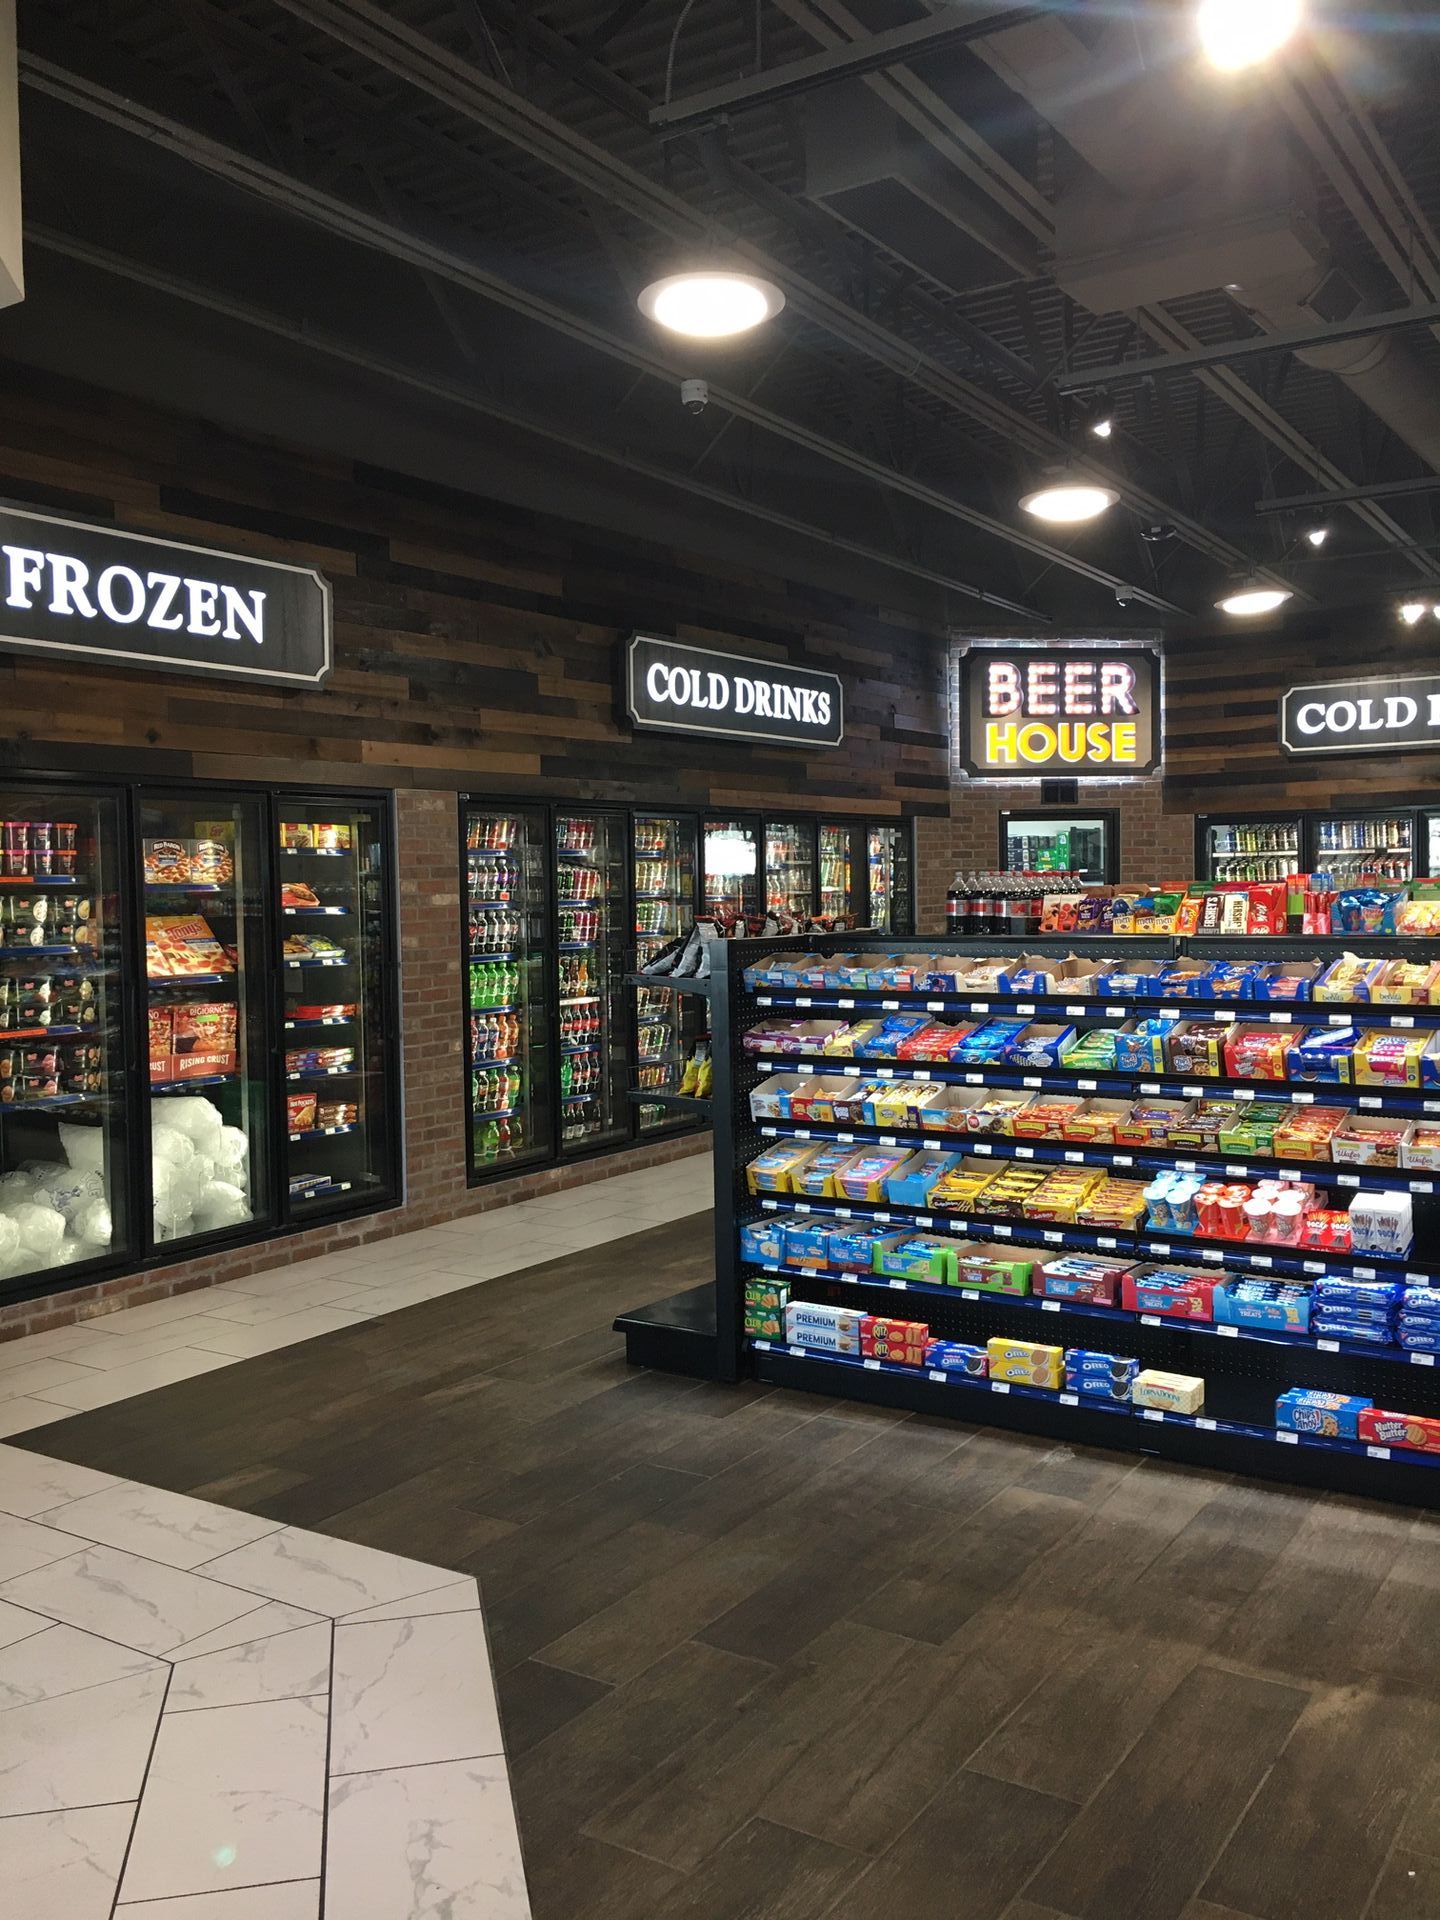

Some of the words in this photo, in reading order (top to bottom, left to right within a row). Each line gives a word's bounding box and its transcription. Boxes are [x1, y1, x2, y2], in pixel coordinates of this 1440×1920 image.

[1, 545, 267, 644] FROZEN
[647, 662, 730, 711] COLD
[733, 676, 831, 726] DRINKS
[986, 661, 1139, 716] BEER
[1296, 696, 1418, 735] COLD
[986, 722, 1137, 763] HOUSE
[180, 1055, 205, 1072] RISING
[206, 1054, 230, 1065] CRUST
[1322, 1287, 1352, 1295] OREO
[1323, 1305, 1352, 1313] OREO
[796, 1313, 836, 1328] PREMIUM
[796, 1332, 837, 1347] PREMIUM
[1004, 1351, 1030, 1359] OREO
[942, 1358, 965, 1366] OREO
[1082, 1362, 1110, 1370] OREO
[1006, 1369, 1031, 1377] OREO
[1083, 1381, 1110, 1389] OREO
[1375, 1421, 1403, 1433] Nutter
[1379, 1428, 1408, 1441] Butter
